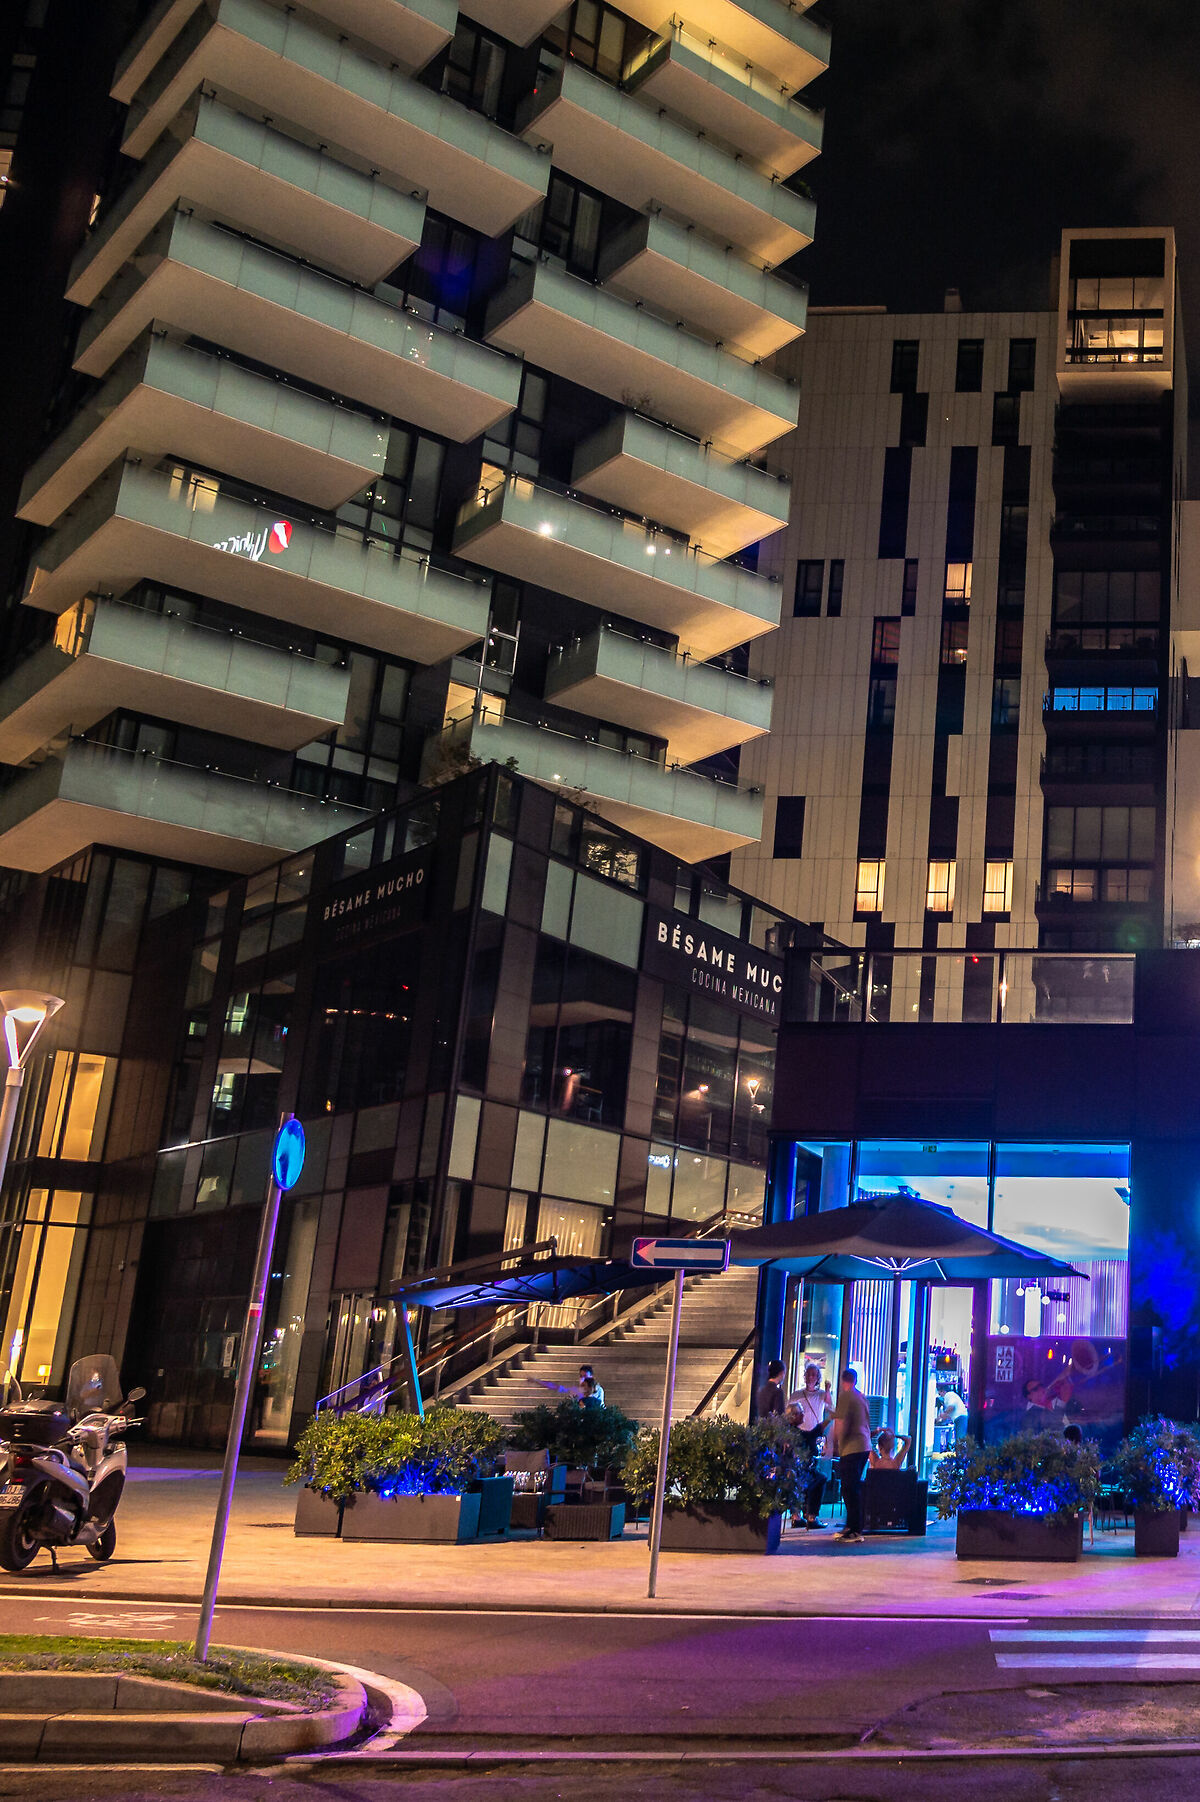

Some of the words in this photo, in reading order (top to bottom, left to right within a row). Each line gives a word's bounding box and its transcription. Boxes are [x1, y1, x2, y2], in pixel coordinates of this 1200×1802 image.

[324, 890, 371, 920] BÉSAME
[377, 868, 424, 900] MUCHO
[658, 922, 735, 973] BÉSAME
[746, 962, 783, 993] MUC
[691, 967, 727, 995] COCINA
[732, 984, 776, 1015] MEXICANA
[997, 1347, 1013, 1358] JA
[997, 1359, 1012, 1369] ZZ
[997, 1370, 1012, 1381] MI
